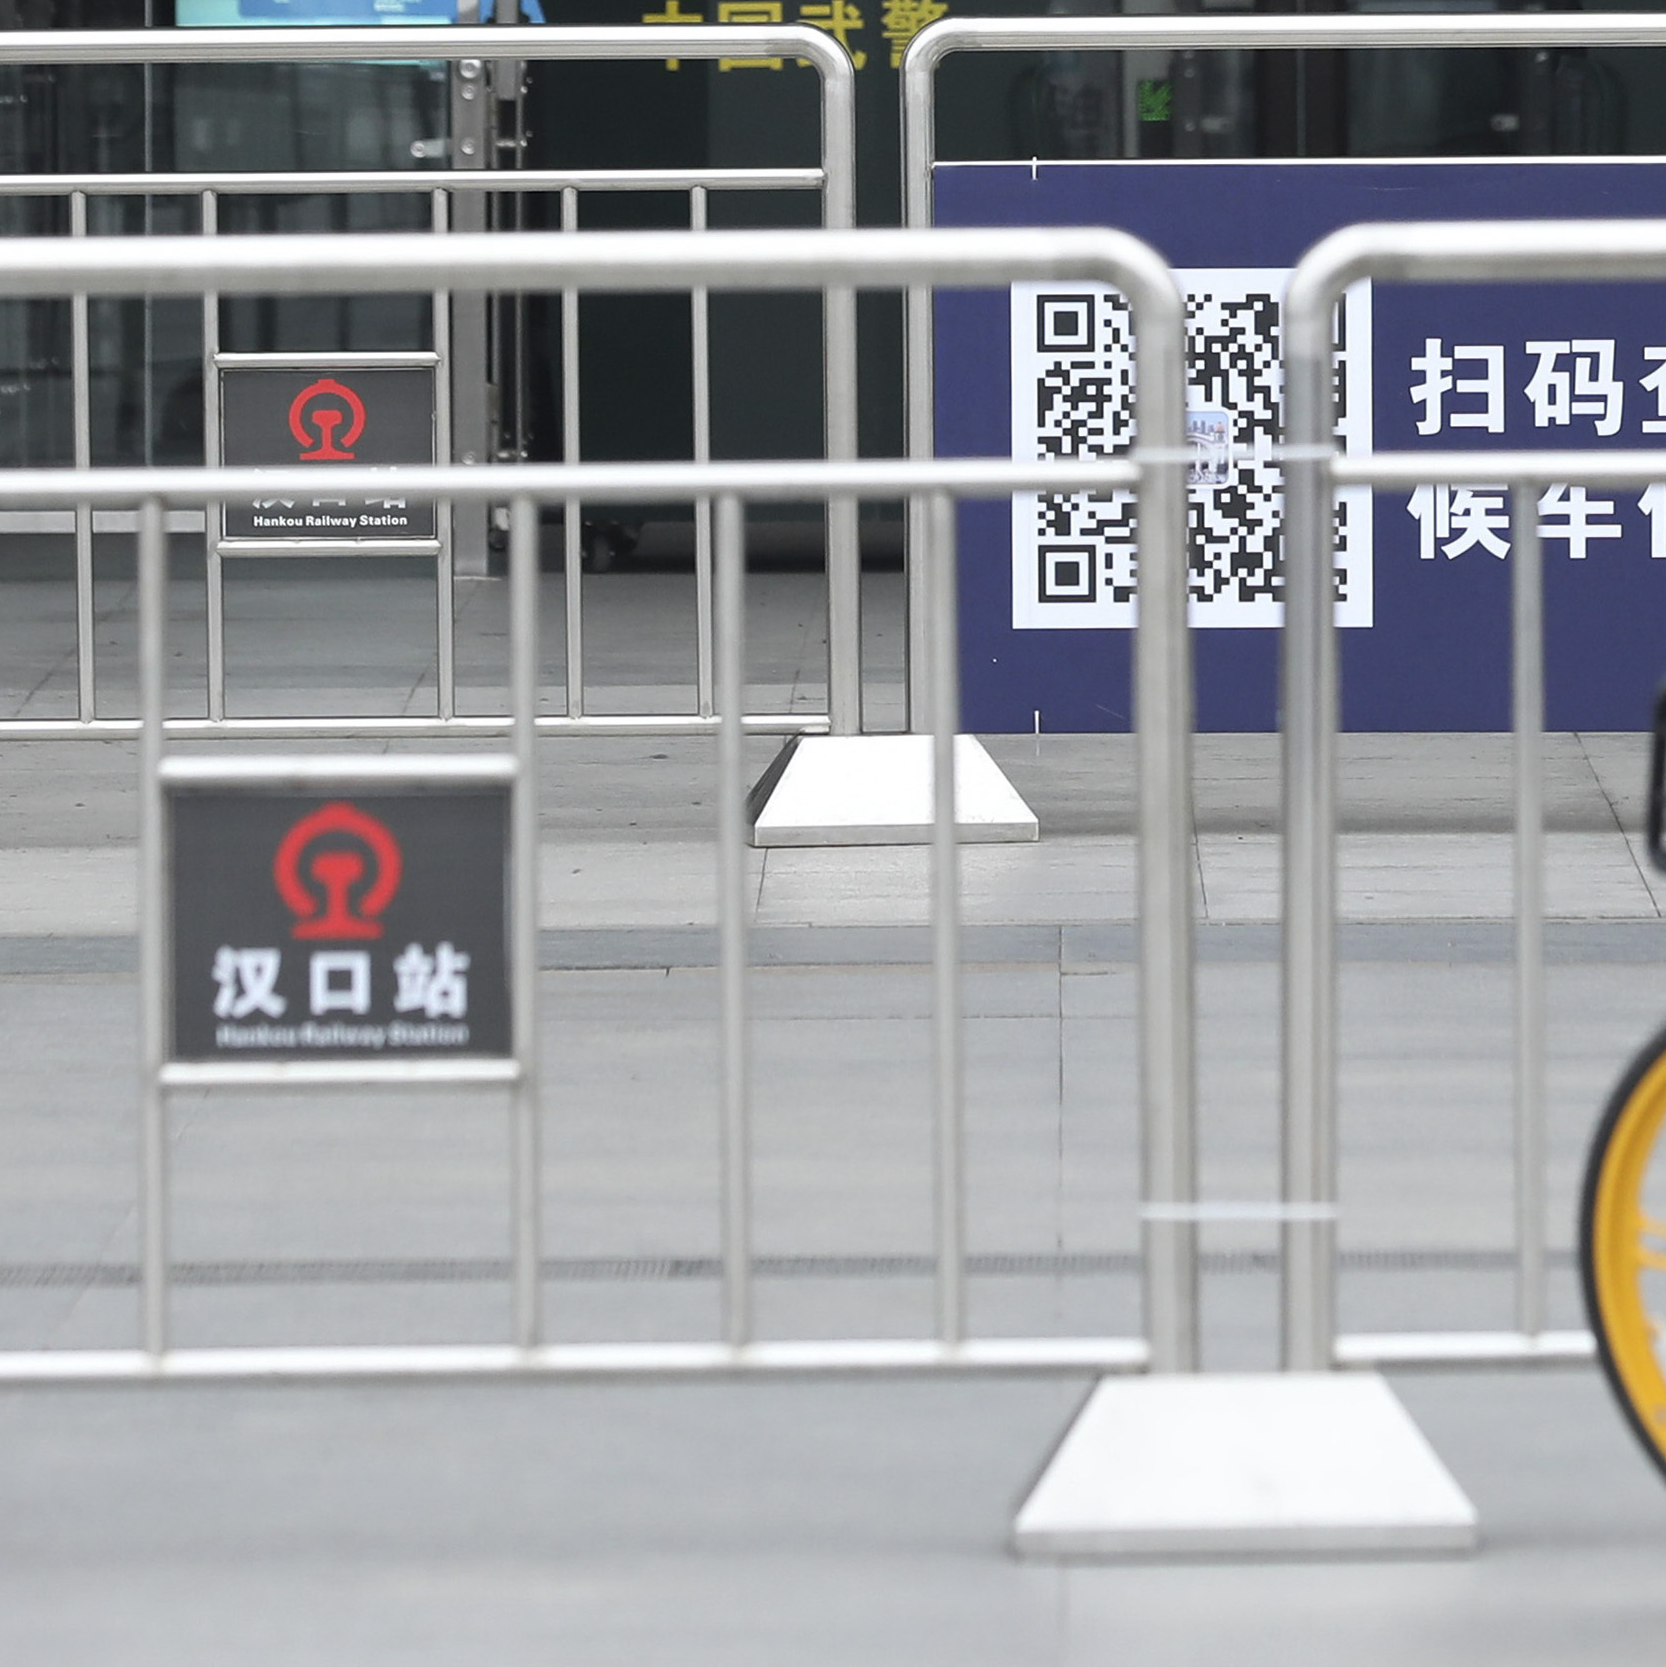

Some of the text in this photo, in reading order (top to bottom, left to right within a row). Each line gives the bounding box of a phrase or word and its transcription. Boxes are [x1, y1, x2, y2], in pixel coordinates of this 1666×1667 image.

[253, 514, 408, 529] Hankou Railway Station
[211, 940, 472, 1020] 汉口站
